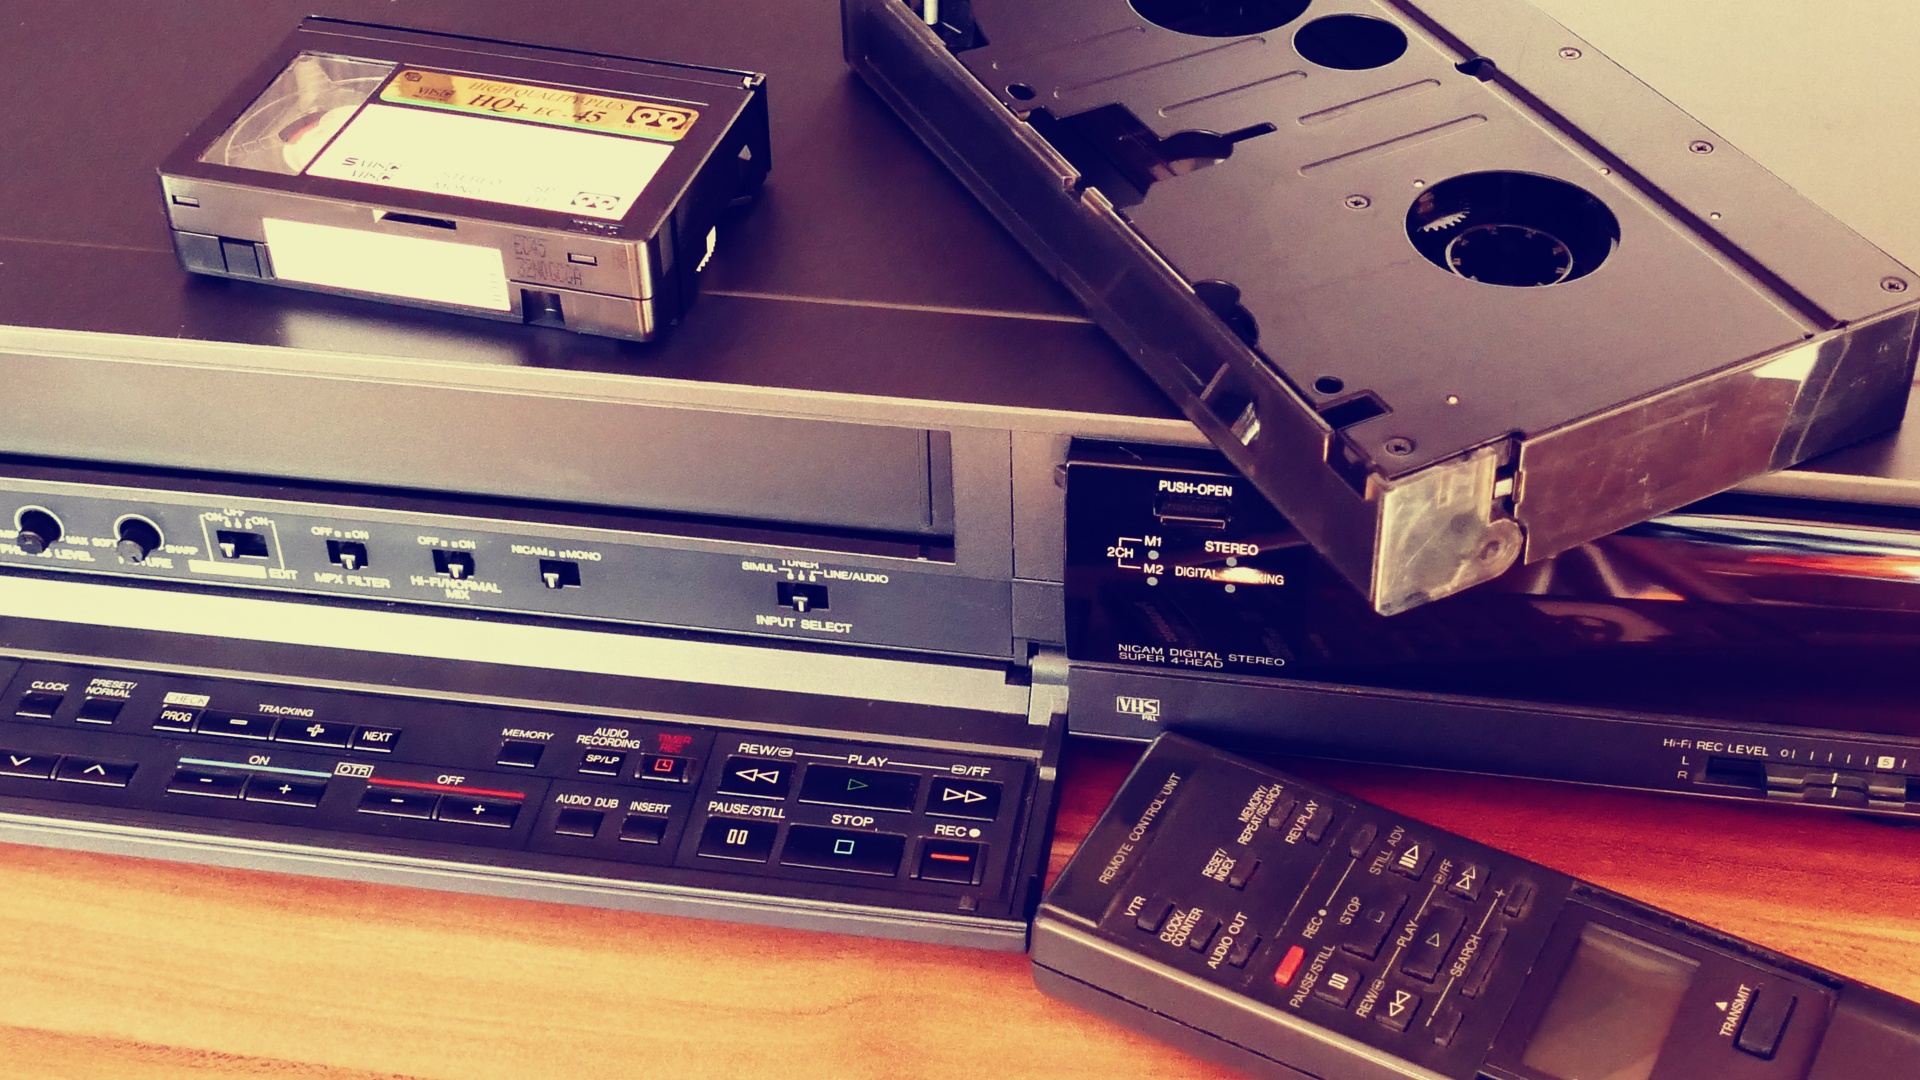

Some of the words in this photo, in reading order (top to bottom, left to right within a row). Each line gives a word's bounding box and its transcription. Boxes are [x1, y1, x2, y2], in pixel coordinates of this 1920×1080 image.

[468, 94, 528, 112] HQ+
[1158, 480, 1233, 497] PUSH-OPEN
[204, 512, 222, 522] ON
[251, 516, 269, 526] ON
[311, 526, 333, 537] OFF
[351, 529, 369, 540] ON
[417, 535, 439, 547] OFF
[458, 539, 476, 550] ON
[1144, 535, 1162, 547] M1
[1204, 540, 1259, 556] STEREO
[54, 548, 96, 562] LEVEL
[165, 544, 199, 555] SHARP
[511, 544, 548, 557] NICAM
[565, 550, 602, 562] MONO
[1107, 546, 1134, 558] 2CH
[268, 567, 298, 580] EDIT
[742, 561, 777, 573] SIMUL
[1143, 564, 1164, 575] M2
[1174, 565, 1219, 580] DIGITAL
[314, 572, 344, 585] MPX
[347, 575, 391, 589] FILTER
[823, 569, 889, 584] LINE/AUDIO
[446, 588, 470, 601] MIX
[756, 614, 796, 628] INPUT
[800, 619, 853, 634] SELECT
[1118, 643, 1163, 655] NICAM
[1169, 648, 1222, 661] DIGITAL
[1228, 654, 1285, 667] STEREO
[1118, 651, 1165, 663] SUPER
[1170, 657, 1223, 669] 4-HEAD
[31, 680, 69, 692] CLOCK
[90, 678, 138, 690] PRESET/
[85, 686, 132, 699] NORMAL
[166, 694, 206, 705] CHECK
[258, 704, 314, 718] TRACKING
[1118, 697, 1158, 715] VHS
[161, 710, 192, 723] PROG
[1142, 714, 1158, 722] PAL
[362, 730, 393, 743] NEXT
[502, 728, 555, 741] MEMORY
[594, 727, 629, 739] AUDIO
[658, 733, 693, 746] TIMER
[576, 735, 641, 749] RECORDING
[1663, 738, 1692, 749] Hi-Fi
[1696, 741, 1723, 752] REC
[1727, 744, 1769, 757] LEVEL
[248, 755, 270, 766] ON
[585, 753, 620, 765] SP/LP
[847, 754, 889, 768] PLAY
[1682, 755, 1689, 765] L
[338, 764, 371, 777] OTR
[1677, 770, 1688, 779] R
[437, 774, 465, 786] OFF
[555, 793, 592, 806] AUDIO
[594, 797, 620, 809] DUB
[630, 801, 671, 814] INSERT
[1237, 785, 1269, 823] MEMORY/
[707, 801, 786, 819] PAUSE/STILL
[1237, 783, 1284, 845] REPEAT/SEARCH
[831, 814, 874, 828] STOP
[934, 824, 967, 837] REC
[1099, 843, 1133, 885] REMOTE
[1128, 793, 1167, 843] CONTROL
[1161, 772, 1182, 800] UNIT
[1369, 849, 1393, 876] STILL
[1386, 825, 1406, 848] ADV
[1202, 848, 1228, 878] RESET/
[1213, 857, 1237, 882] INDEX
[1124, 895, 1147, 917] VTR
[1339, 896, 1362, 926] STOP
[1159, 910, 1186, 943] CLOCK/
[1171, 907, 1204, 947] COUNTER
[1302, 916, 1323, 940] REC
[1396, 919, 1419, 948] PLAY
[1207, 935, 1233, 970] AUDIO
[1228, 911, 1249, 936] OUT
[1450, 934, 1482, 978] SEARCH
[1289, 944, 1336, 1009] PAUSE/STILL
[1719, 983, 1752, 1038] TRANSMIT
